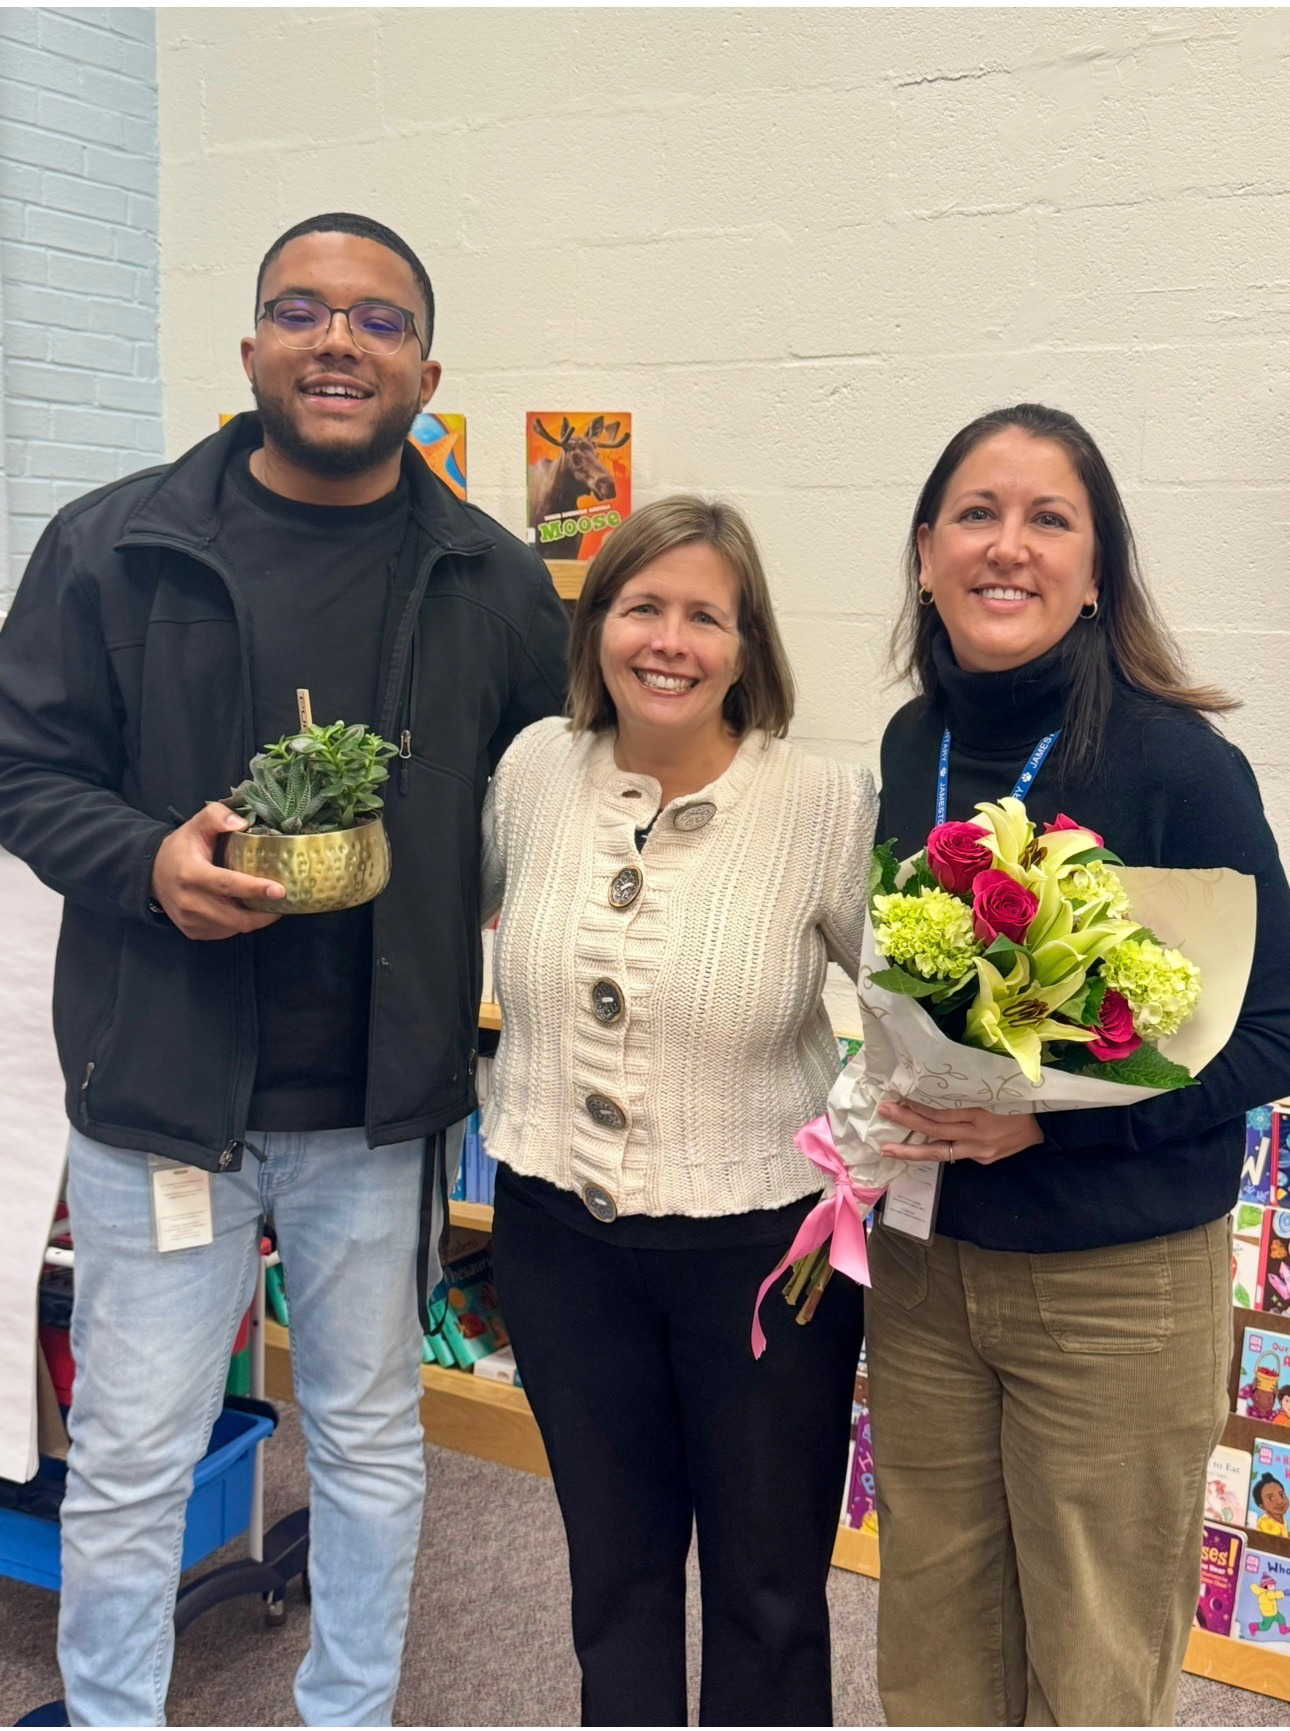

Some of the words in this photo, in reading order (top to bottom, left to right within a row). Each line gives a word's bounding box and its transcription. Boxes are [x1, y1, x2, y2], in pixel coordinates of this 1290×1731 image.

[538, 510, 621, 543] Moose
[1213, 1461, 1223, 1469] to
[1225, 1462, 1241, 1474] Eat
